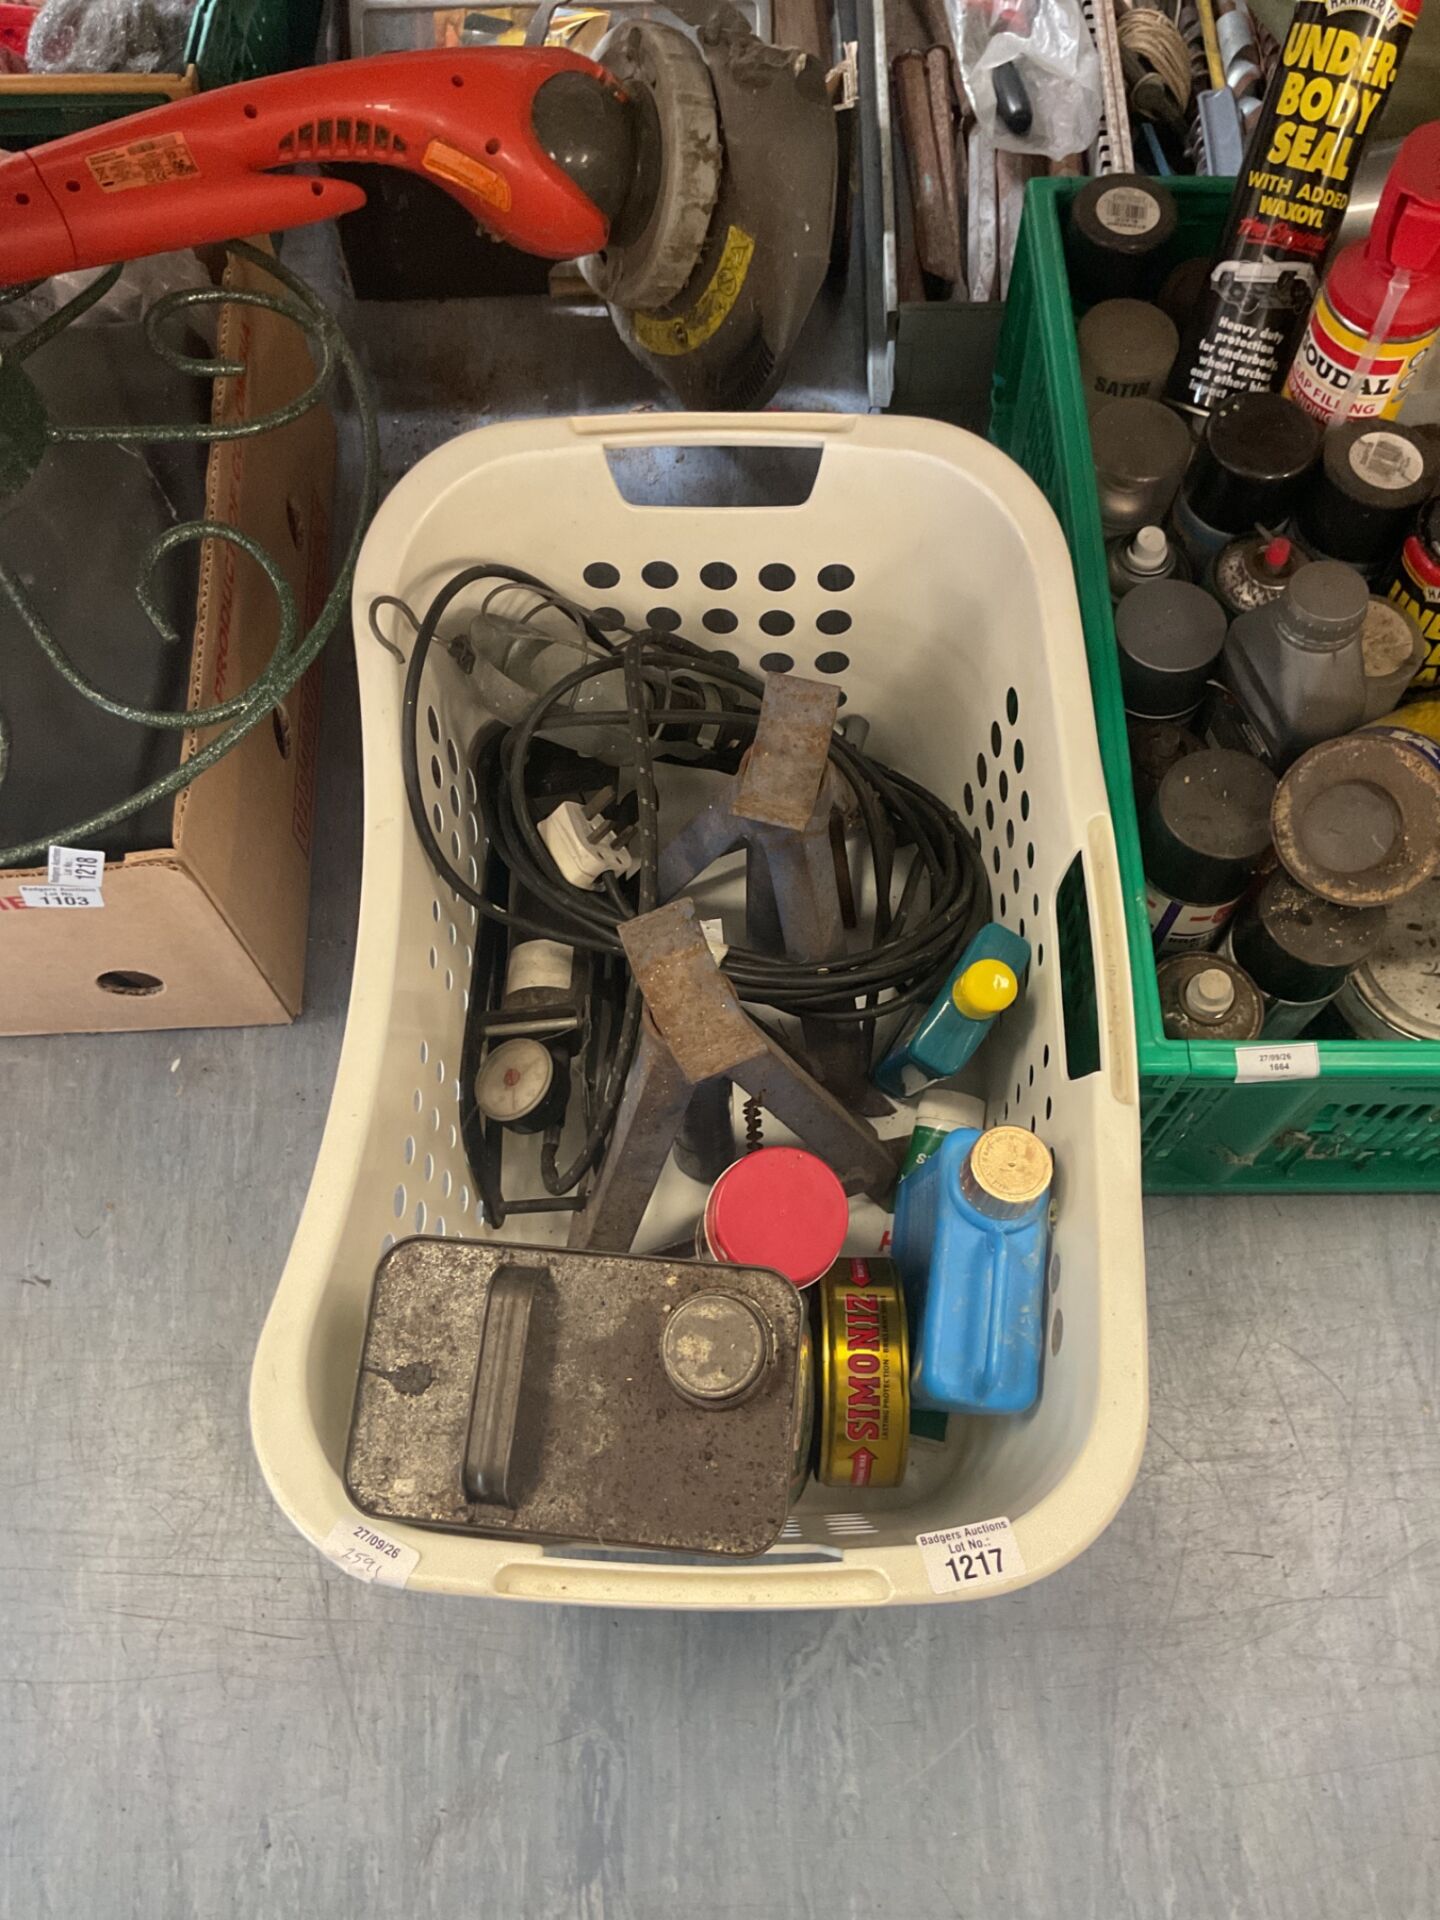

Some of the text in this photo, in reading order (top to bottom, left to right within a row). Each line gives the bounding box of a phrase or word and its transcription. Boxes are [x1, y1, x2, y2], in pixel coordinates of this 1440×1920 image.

[1276, 72, 1381, 135] BODY
[1267, 121, 1354, 181] SEAL
[1248, 170, 1349, 210] WITH ADDED
[1259, 195, 1325, 228] WAXOYL
[1215, 332, 1274, 354] protection
[1218, 316, 1284, 345] Heavy duty
[1199, 338, 1215, 353] for
[1190, 367, 1212, 380] and
[1213, 375, 1247, 390] other
[1199, 355, 1272, 381] wheel arches
[1094, 376, 1151, 398] SATIN
[75, 857, 98, 879] 1218
[40, 896, 89, 906] 1103
[845, 1293, 881, 1441] SIMONIZ
[882, 1361, 890, 1408] PROTECTION
[353, 1526, 401, 1559] 27/09/26
[920, 1520, 1007, 1546] Badgers Auctions
[948, 1543, 966, 1554] Lot
[945, 1548, 1003, 1582] 1217
